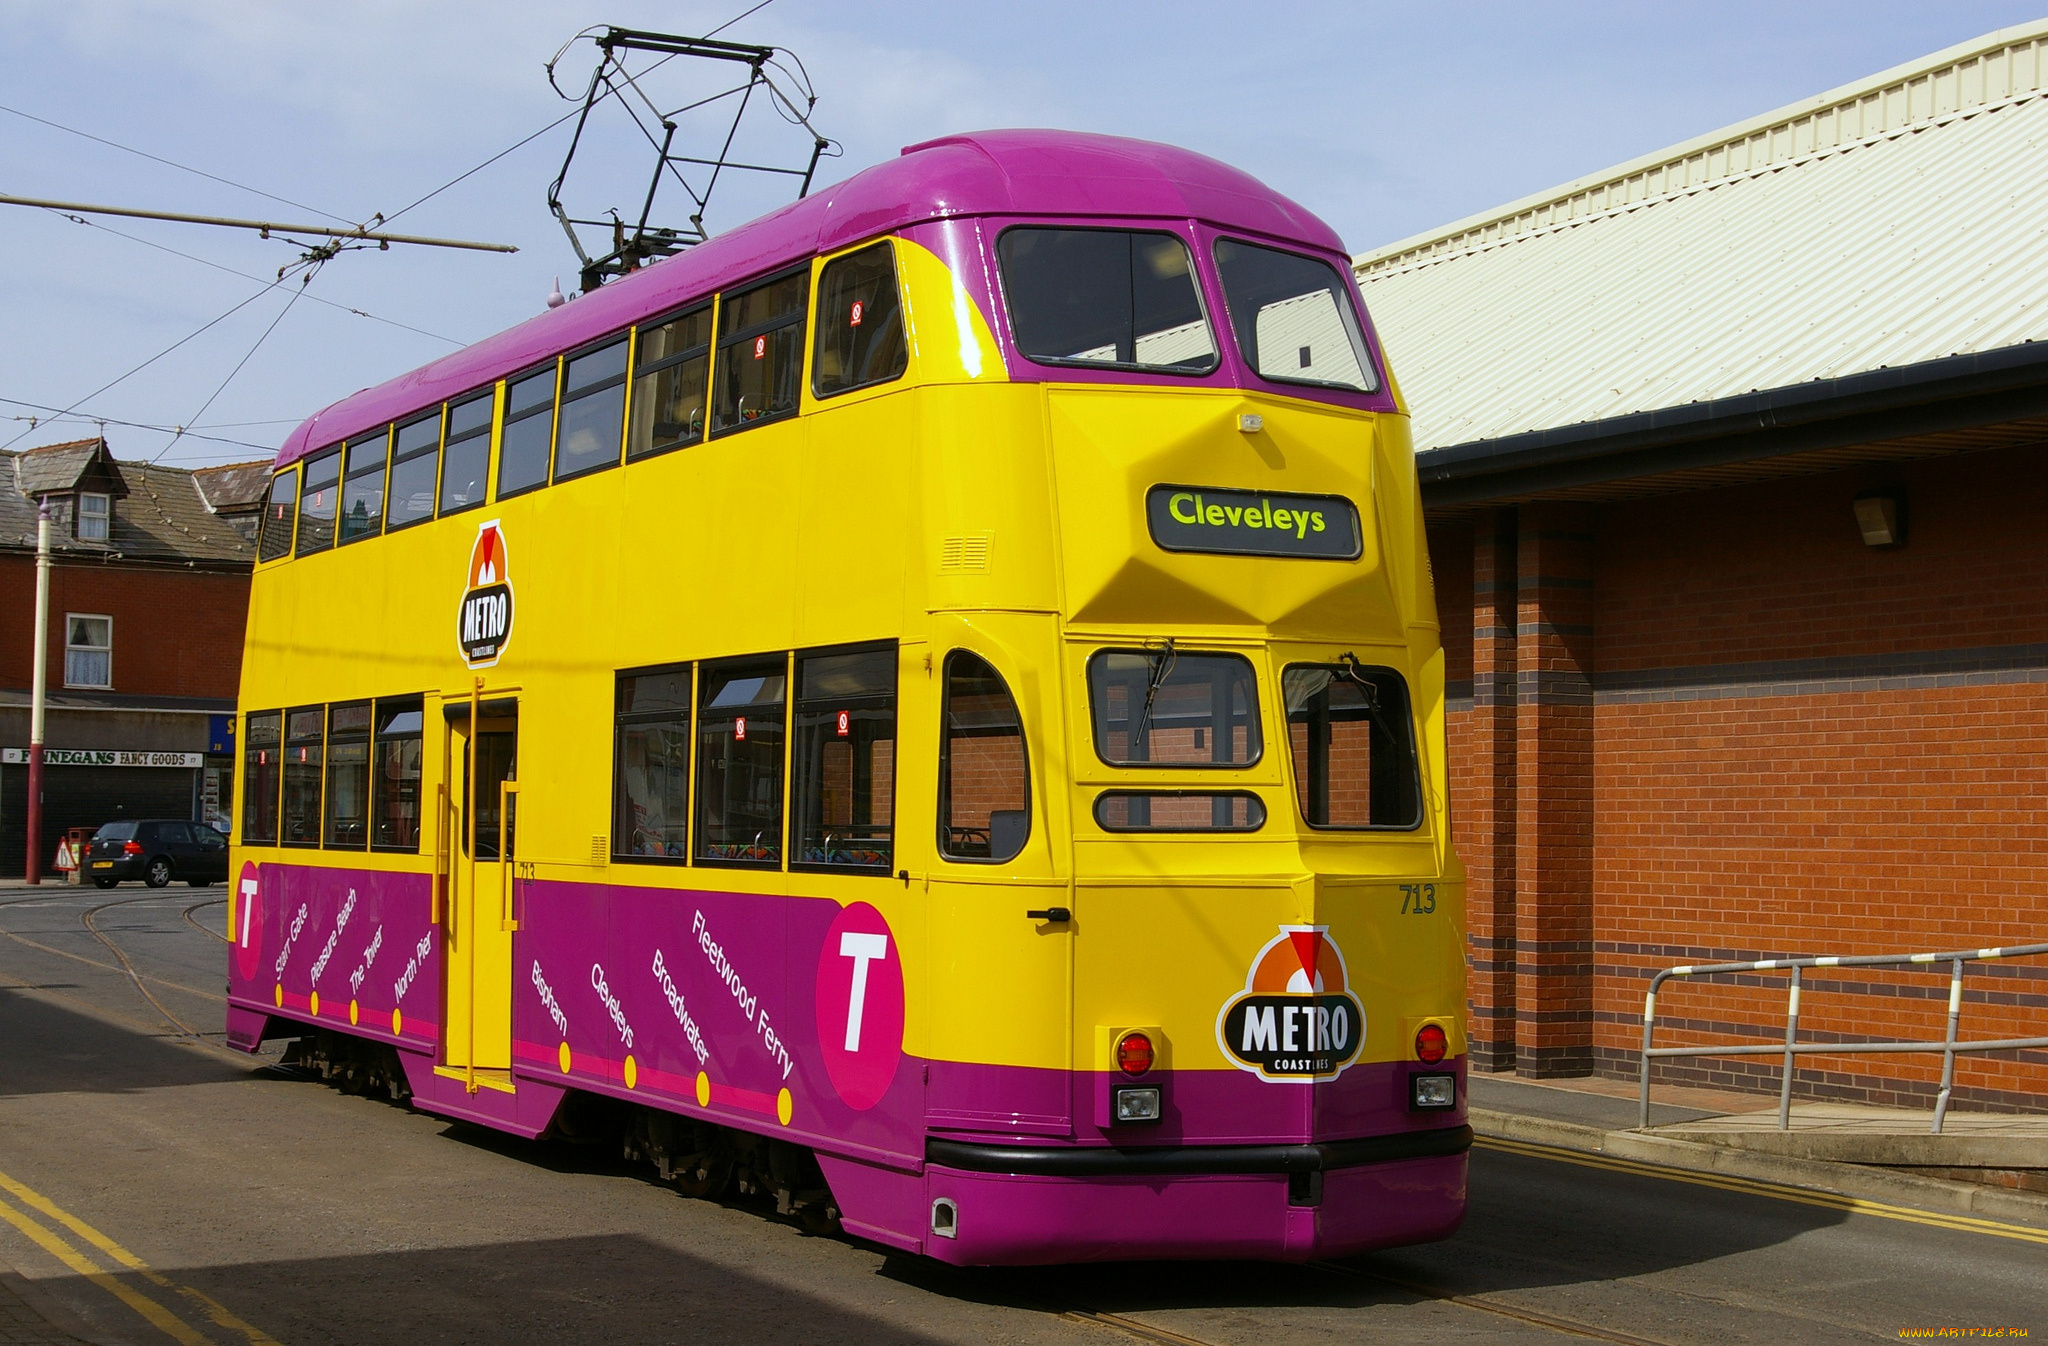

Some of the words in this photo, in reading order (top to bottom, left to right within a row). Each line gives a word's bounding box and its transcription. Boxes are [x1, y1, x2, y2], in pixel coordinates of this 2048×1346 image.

[1168, 492, 1327, 540] Cleveleys
[463, 592, 507, 643] METRO
[20, 749, 116, 764] FNEGANS
[120, 752, 149, 765] FANCY
[152, 754, 186, 765] GOODS
[519, 862, 535, 886] 713
[1399, 883, 1436, 915] 713
[241, 878, 258, 948] T
[275, 937, 291, 981] Starr
[290, 902, 308, 942] Gate
[310, 928, 337, 988] Pleasure
[336, 887, 357, 935] Beach
[349, 962, 365, 995] The
[362, 924, 383, 970] Tower
[394, 958, 417, 1004] North
[416, 930, 433, 967] Pier
[692, 909, 758, 1022] Fleetwood
[756, 1008, 794, 1080] Ferry
[839, 931, 888, 1052] T
[531, 959, 568, 1037] Bispham
[591, 963, 635, 1049] Cleveleys
[652, 948, 710, 1066] Broadwater
[1241, 1005, 1348, 1052] METRO
